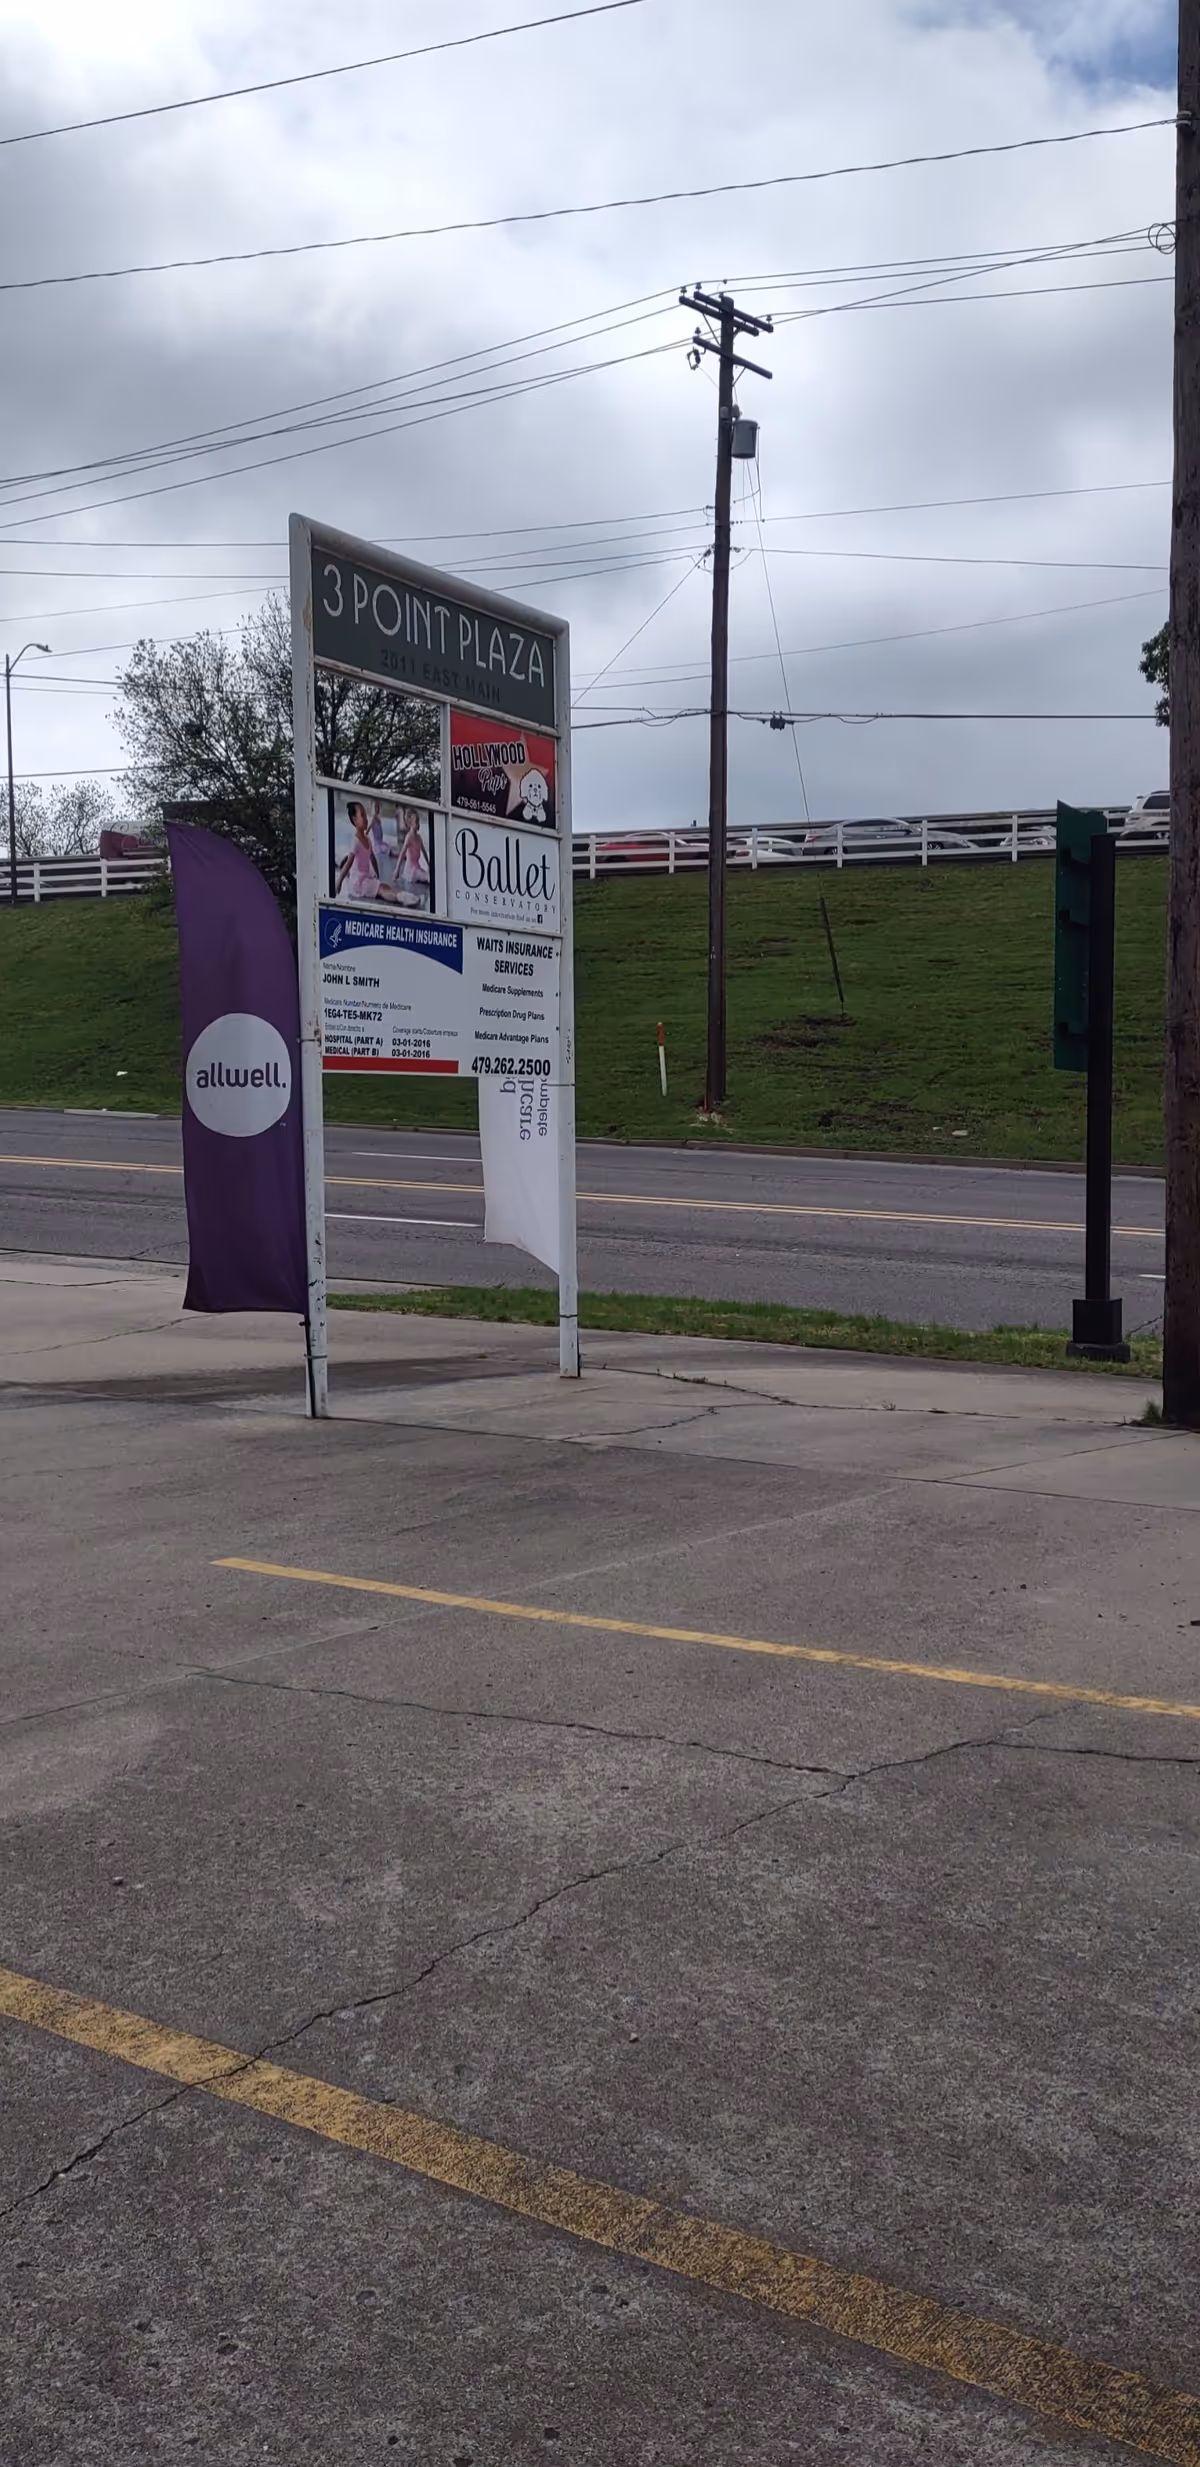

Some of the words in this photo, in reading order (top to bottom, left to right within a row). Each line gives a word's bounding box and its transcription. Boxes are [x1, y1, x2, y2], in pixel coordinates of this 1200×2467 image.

[323, 563, 344, 617] 3
[354, 573, 451, 654] POINT
[459, 613, 545, 688] PLAZA
[381, 648, 416, 674] 2011
[423, 663, 460, 687] EAST
[466, 675, 500, 703] MAIN
[452, 741, 526, 770] HOLLYWOOD
[478, 767, 508, 796] Pups
[455, 828, 556, 901] Ballet
[455, 889, 556, 914] CONSERVATORY
[345, 920, 385, 939] MEDICARE
[386, 925, 415, 942] HEALTH
[416, 929, 457, 948] INSURANCE
[477, 937, 504, 953] WAITS
[505, 940, 553, 959] INSURANCE
[494, 960, 534, 976] SERVICES
[323, 973, 344, 984] JOHN
[346, 976, 351, 985] L
[353, 976, 380, 988] SMITH
[482, 983, 506, 995] Medicare
[507, 986, 544, 998] Supplements
[324, 1008, 383, 1021] 1EG4-TE5-MK72
[382, 1002, 389, 1010] de
[390, 1002, 412, 1012] Medicare
[479, 1007, 512, 1019] Prescription
[512, 1010, 526, 1021] Drug
[528, 1011, 545, 1020] Plans
[324, 1034, 353, 1044] HOSPITAL
[354, 1036, 373, 1046] (PART
[375, 1037, 383, 1047] A)
[392, 1038, 431, 1048] 03-01-2016
[474, 1031, 498, 1041] Medicare
[499, 1032, 529, 1044] Advantage
[530, 1034, 549, 1044] Plans
[325, 1046, 350, 1055] MEDICAL
[351, 1047, 370, 1057] (PART
[372, 1048, 380, 1057] B)
[391, 1049, 430, 1058] 03-01-2016
[472, 1056, 551, 1076] 479.262.2500
[196, 1062, 287, 1088] allwell.
